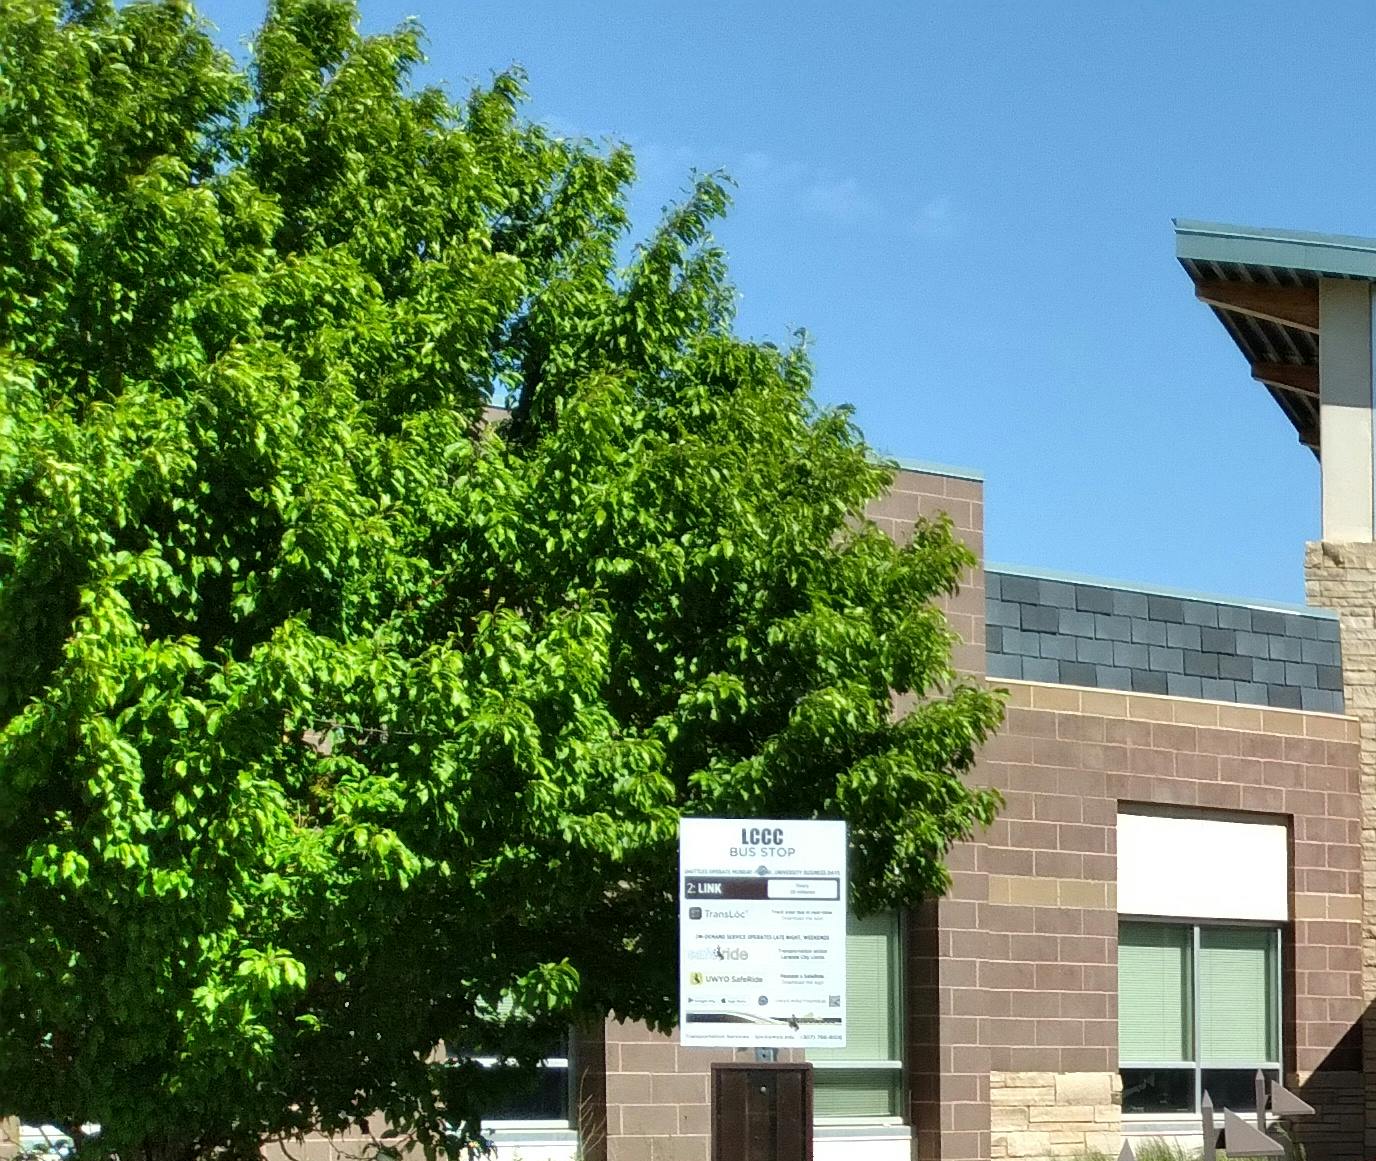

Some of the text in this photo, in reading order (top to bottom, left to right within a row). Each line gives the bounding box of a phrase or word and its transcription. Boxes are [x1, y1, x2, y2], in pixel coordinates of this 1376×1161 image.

[741, 828, 784, 846] LCCC
[729, 847, 796, 858] BUS STOP
[698, 882, 723, 894] LINK
[705, 975, 763, 983] UWYO SafeRide
